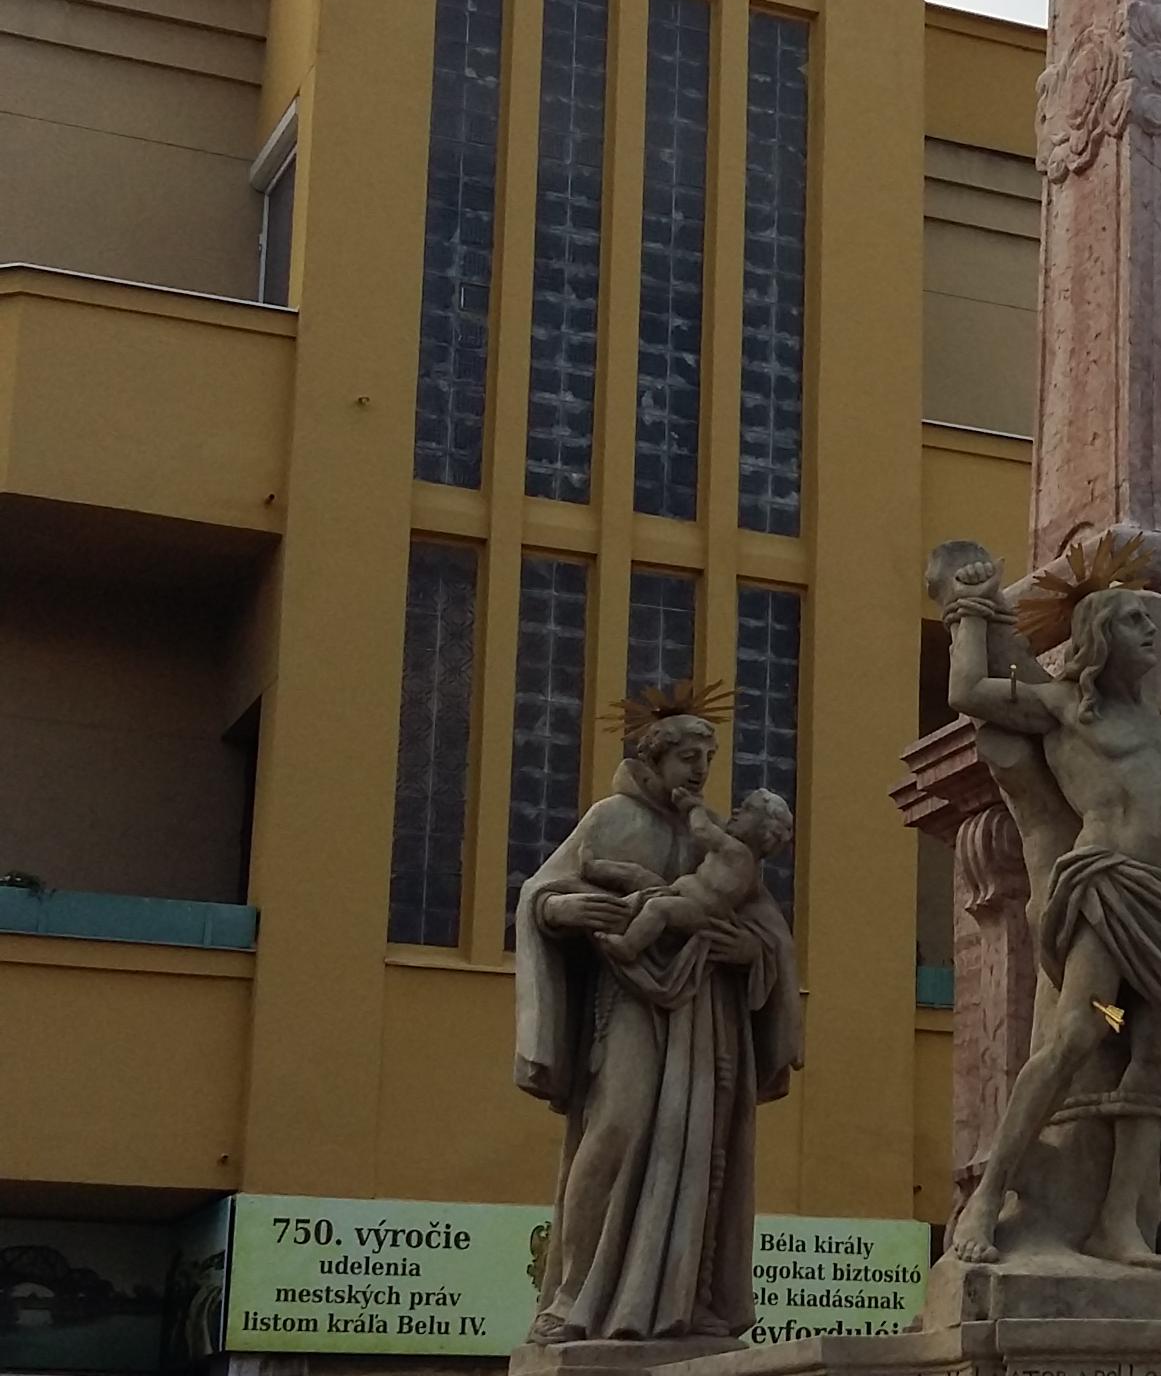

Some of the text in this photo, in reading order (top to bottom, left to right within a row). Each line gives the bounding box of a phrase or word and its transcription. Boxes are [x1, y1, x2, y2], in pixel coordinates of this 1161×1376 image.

[272, 1217, 471, 1254] 750. výročie
[760, 1233, 875, 1260] Béla király
[319, 1256, 421, 1277] udelenia
[831, 1263, 922, 1284] biztosító
[275, 1284, 462, 1310] mestských práv
[786, 1288, 906, 1310] kiadásának
[242, 1311, 487, 1337] listom kráľa Belu IV.
